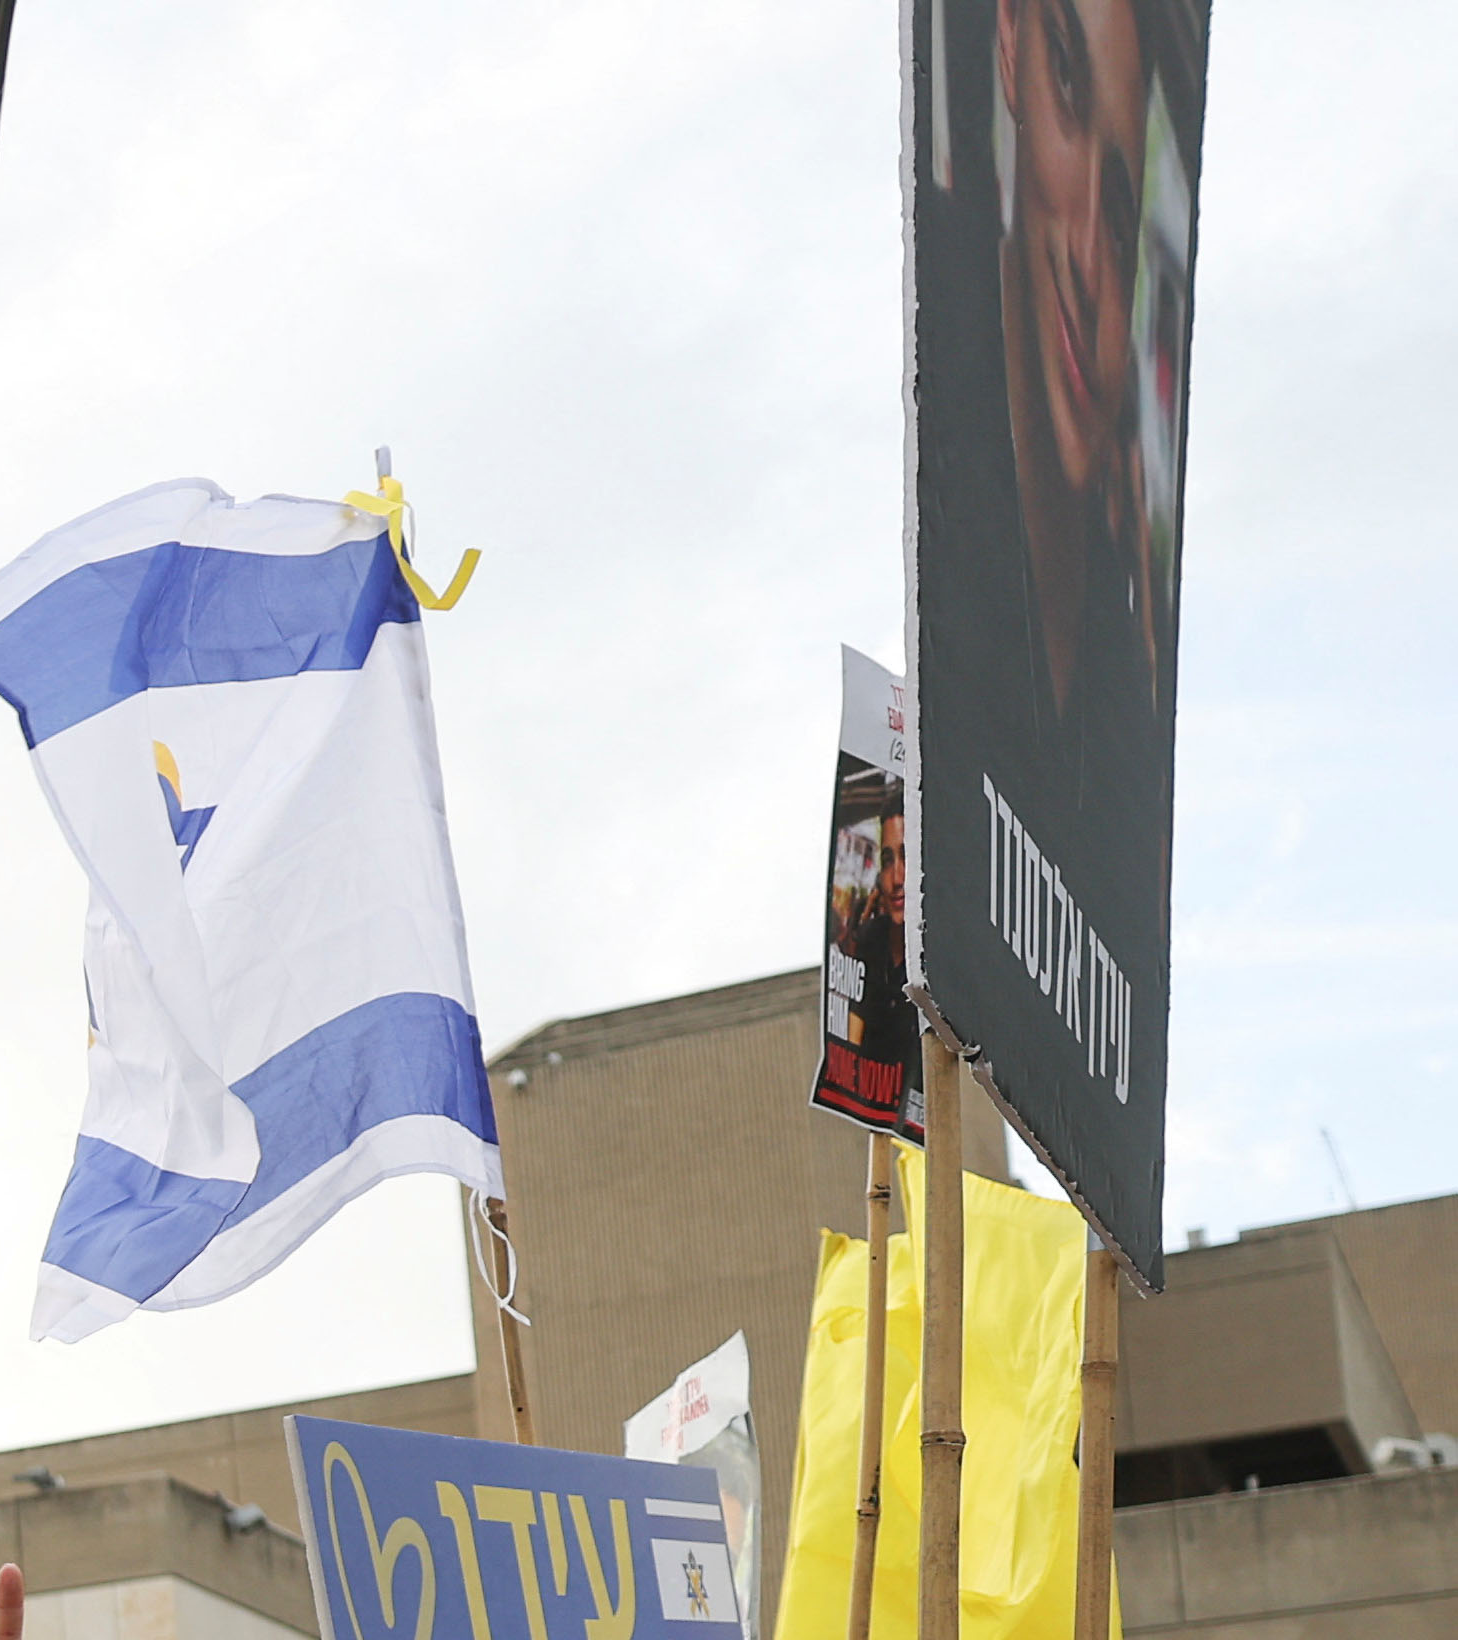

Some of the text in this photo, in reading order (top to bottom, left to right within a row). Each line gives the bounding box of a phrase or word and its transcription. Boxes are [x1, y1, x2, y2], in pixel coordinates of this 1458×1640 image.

[829, 945, 866, 1003] BRING
[983, 772, 1132, 1106] עידן אלכסנדר
